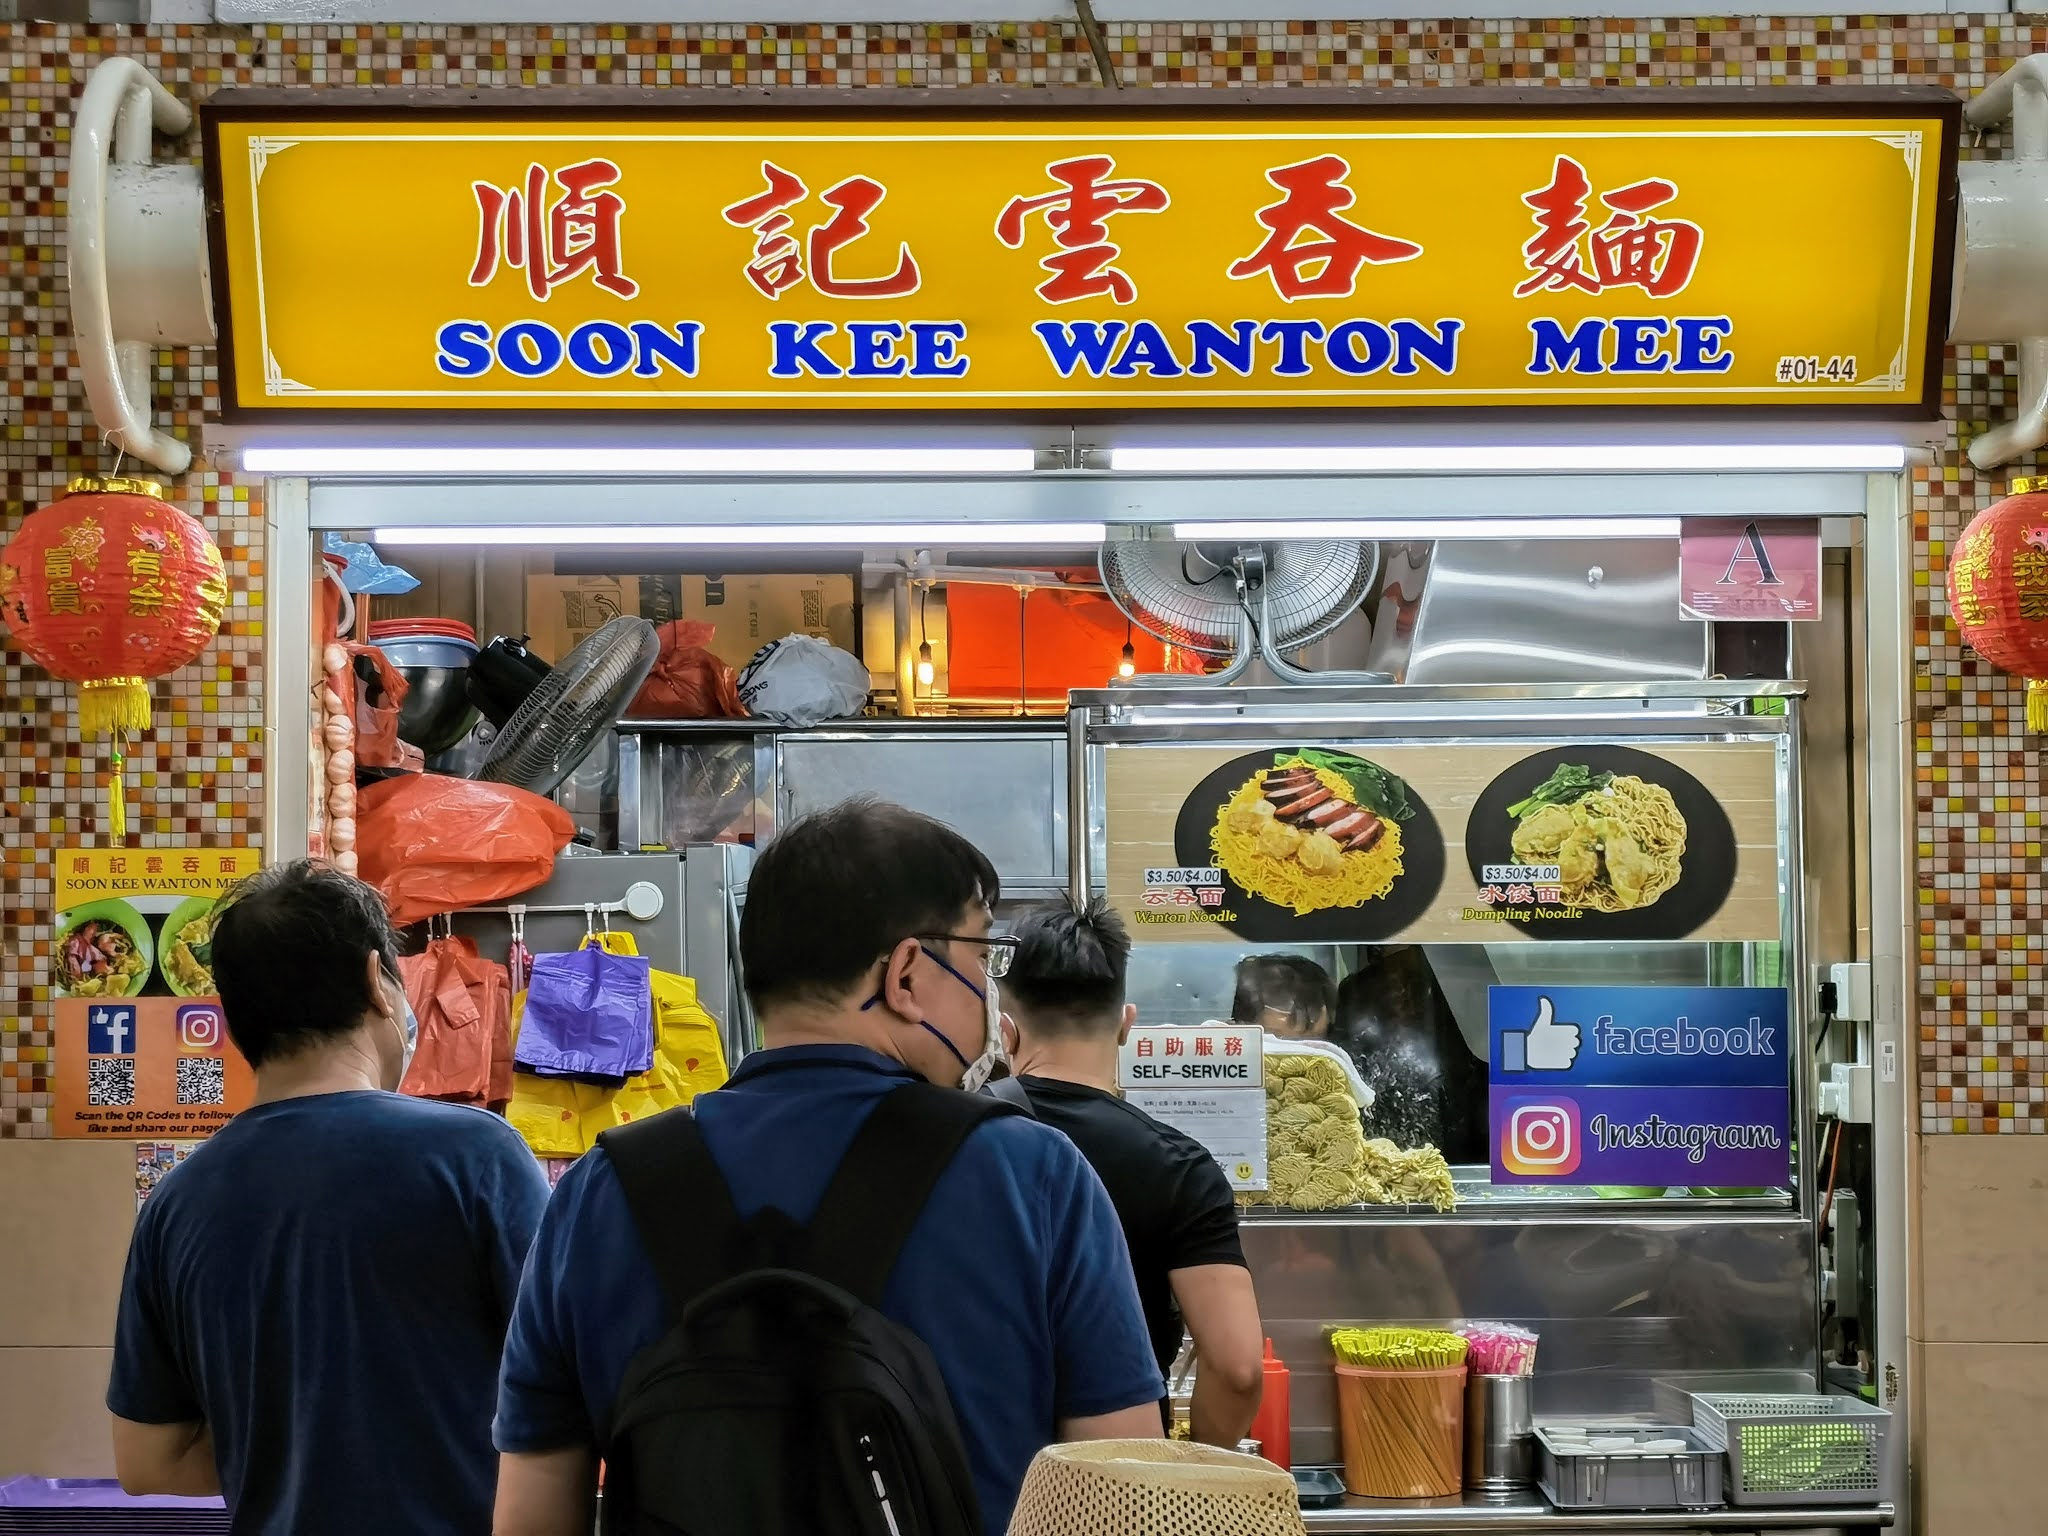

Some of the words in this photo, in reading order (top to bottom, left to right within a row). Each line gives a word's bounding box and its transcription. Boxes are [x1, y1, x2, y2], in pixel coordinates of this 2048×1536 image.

[437, 322, 700, 377] SOON
[770, 322, 968, 377] KEE
[1035, 319, 1461, 377] WANTON
[1529, 317, 1733, 374] MEE
[1779, 358, 1855, 380] #01-44
[1716, 521, 1784, 585] A
[73, 856, 237, 873] 順記雲吞面
[1147, 870, 1220, 883] $3.50/$4.00
[1485, 867, 1559, 880] $3.50/$4.00
[66, 878, 107, 889] SOON
[112, 878, 139, 889] KEE
[143, 877, 211, 889] WANTON
[1142, 889, 1225, 905] 云吞面
[1478, 885, 1562, 904] 水饺面
[1135, 911, 1186, 923] Wanton
[1189, 909, 1237, 922] Noodle
[1463, 907, 1531, 922] Dumpling
[1535, 905, 1584, 919] Noodle
[1592, 1015, 1776, 1056] facebook
[1136, 1037, 1243, 1057] 自助服務
[1132, 1064, 1248, 1079] SELF-SERVICE
[75, 1111, 102, 1120] Scan
[105, 1111, 123, 1120] the
[126, 1111, 143, 1121] QR
[146, 1110, 180, 1120] Codes
[184, 1111, 196, 1120] to
[199, 1110, 234, 1120] follow
[88, 1123, 108, 1133] like
[111, 1123, 132, 1133] and
[135, 1123, 166, 1133] share
[169, 1125, 189, 1133] our
[1590, 1114, 1780, 1163] Instagram
